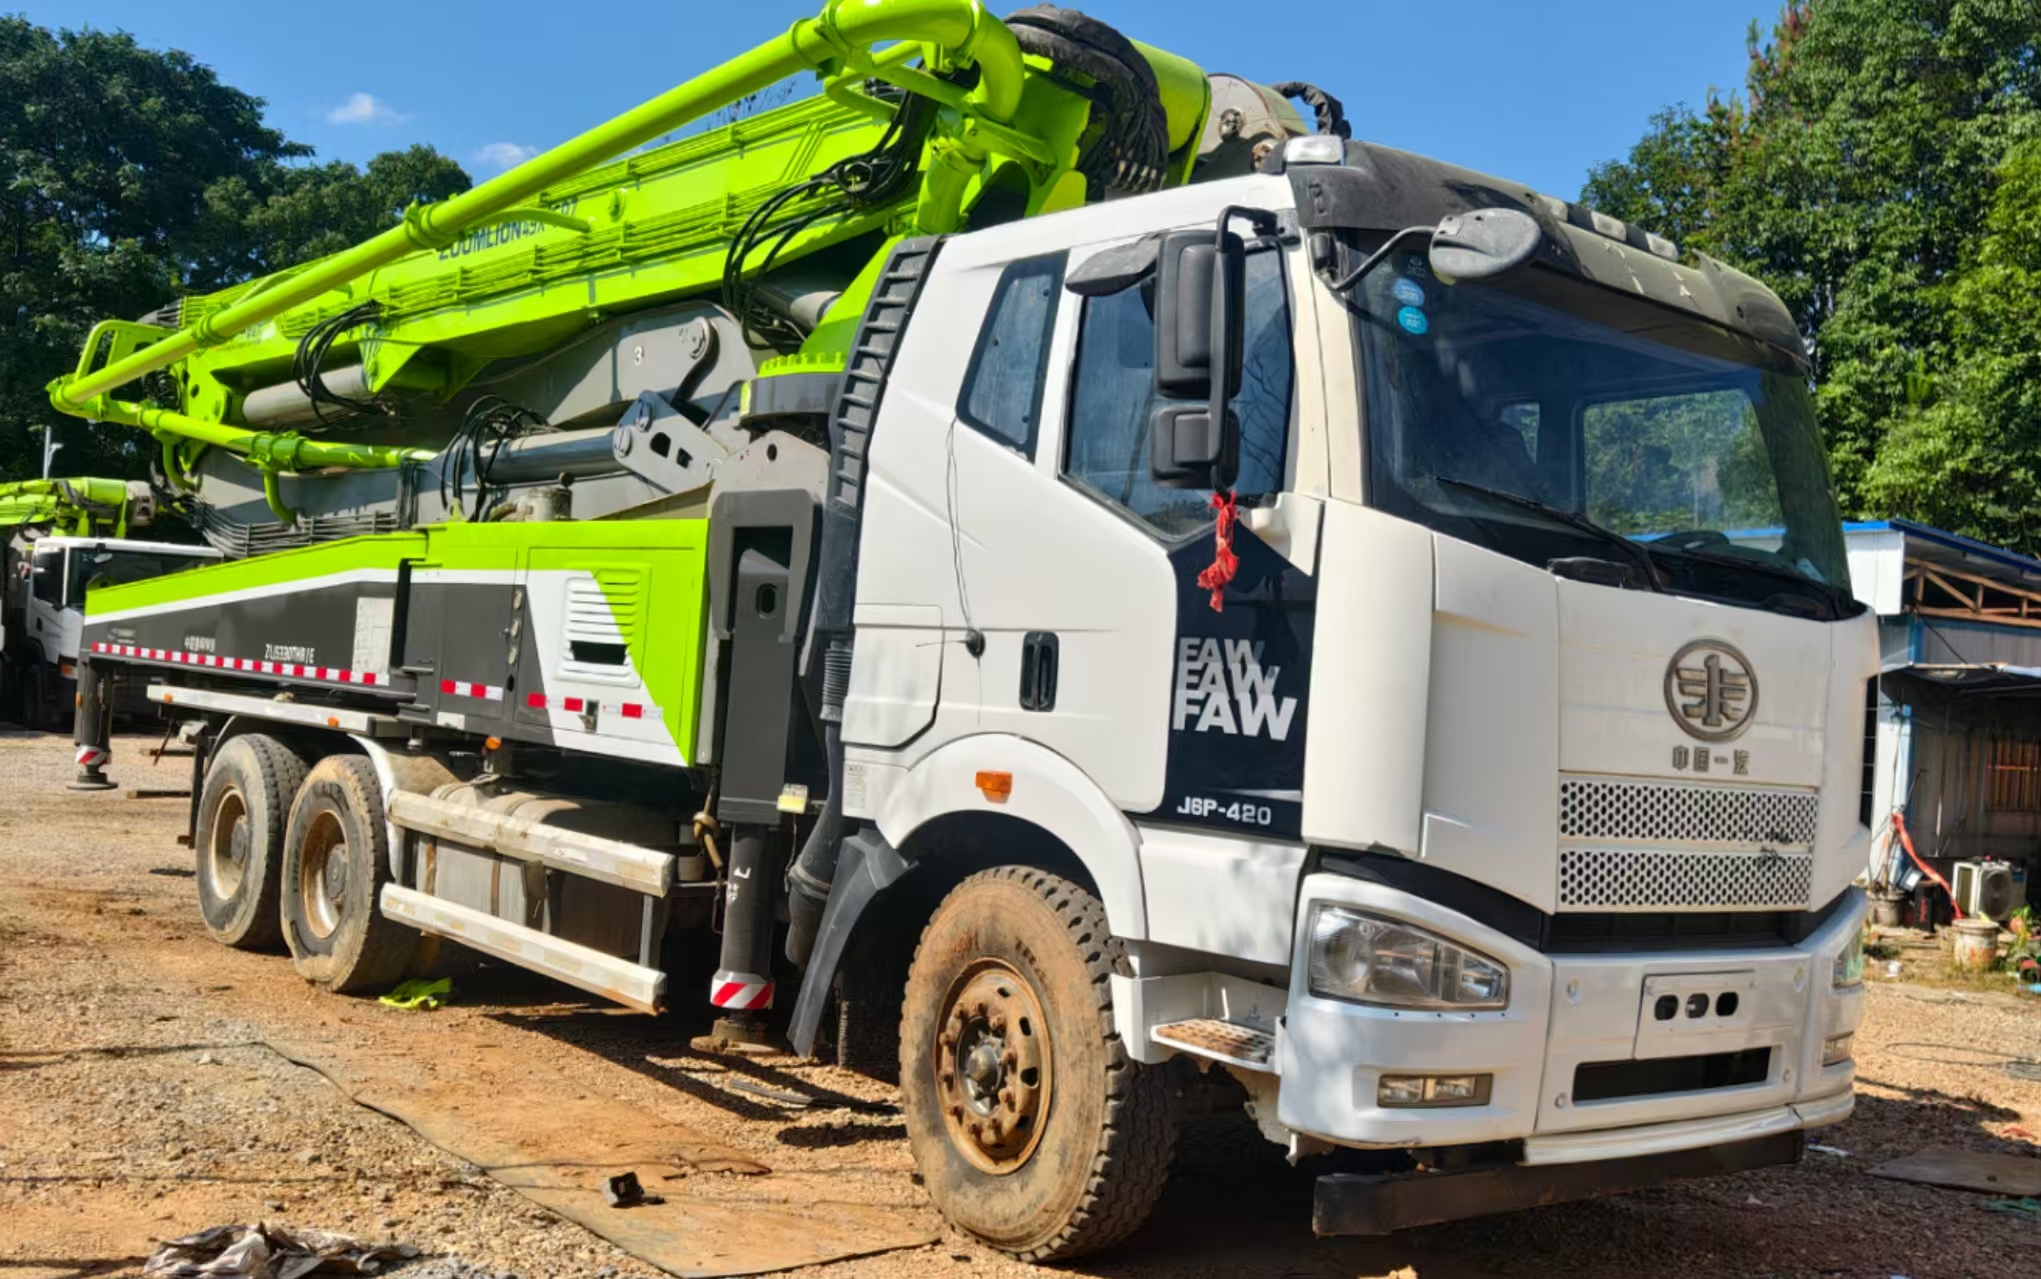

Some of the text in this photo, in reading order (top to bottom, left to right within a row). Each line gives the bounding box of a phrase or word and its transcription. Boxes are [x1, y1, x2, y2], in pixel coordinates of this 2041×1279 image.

[633, 345, 644, 367] 3
[1178, 637, 1265, 671] FAW
[1177, 660, 1281, 702] FAW
[1172, 689, 1298, 741] FAW
[1176, 796, 1272, 826] J6P-420
